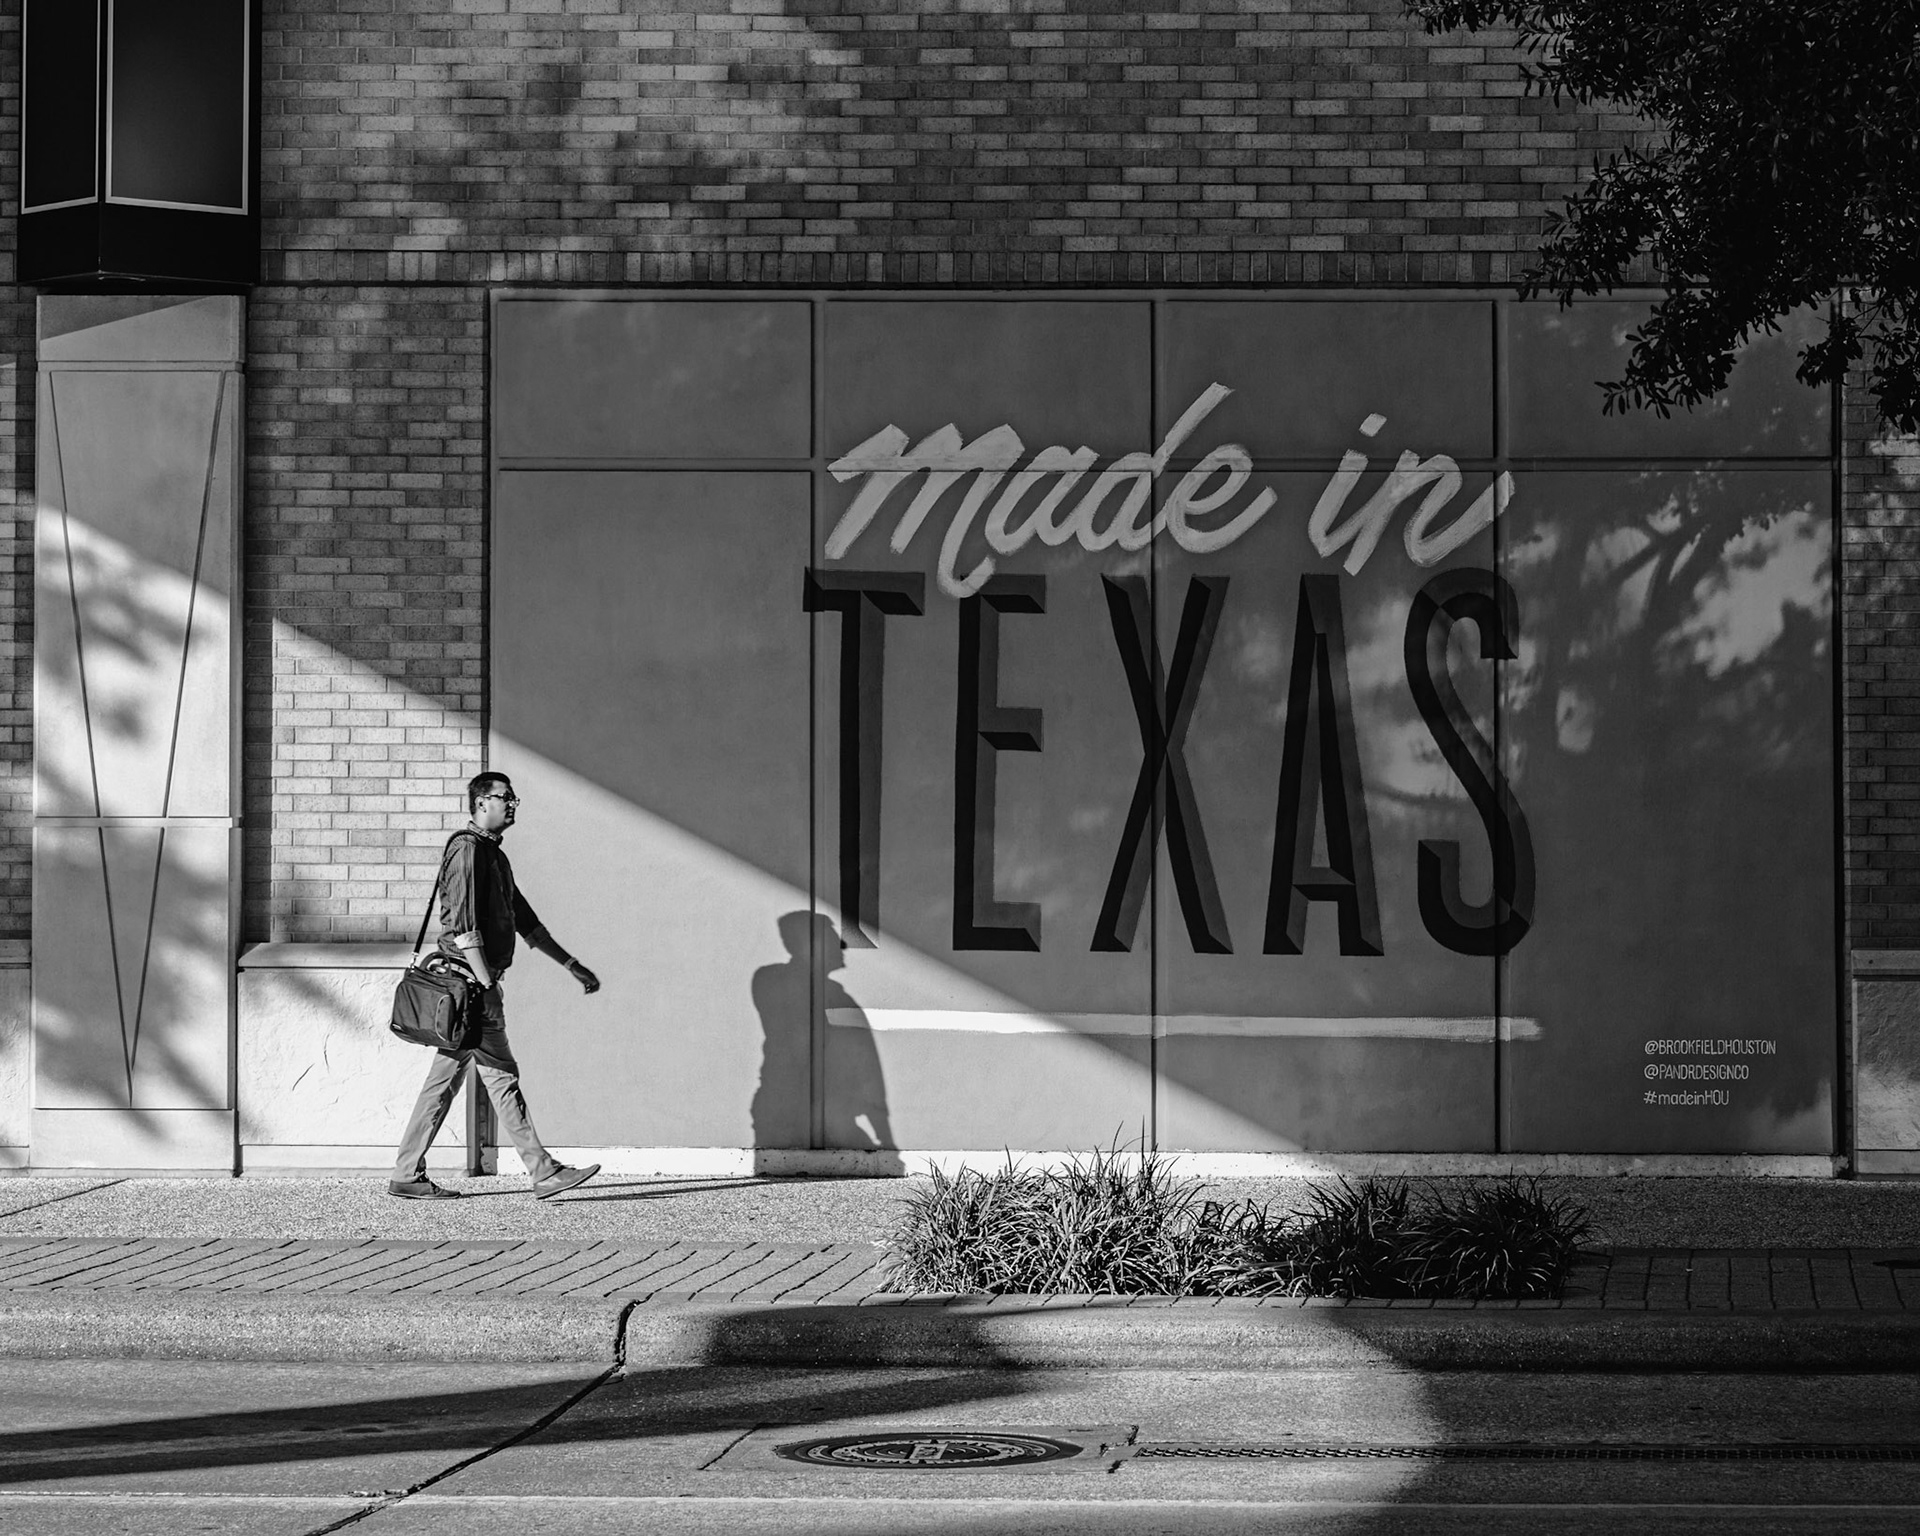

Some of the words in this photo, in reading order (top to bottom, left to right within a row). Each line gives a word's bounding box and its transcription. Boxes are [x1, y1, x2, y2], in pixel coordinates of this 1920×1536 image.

[1309, 413, 1515, 577] in
[803, 567, 1536, 957] TEXAS
[1644, 1038, 1776, 1055] @BROOKFIELDHOUSTON
[1643, 1063, 1750, 1080] @PANDRDESIGNCO
[1643, 1089, 1730, 1106] #madeinHOU
